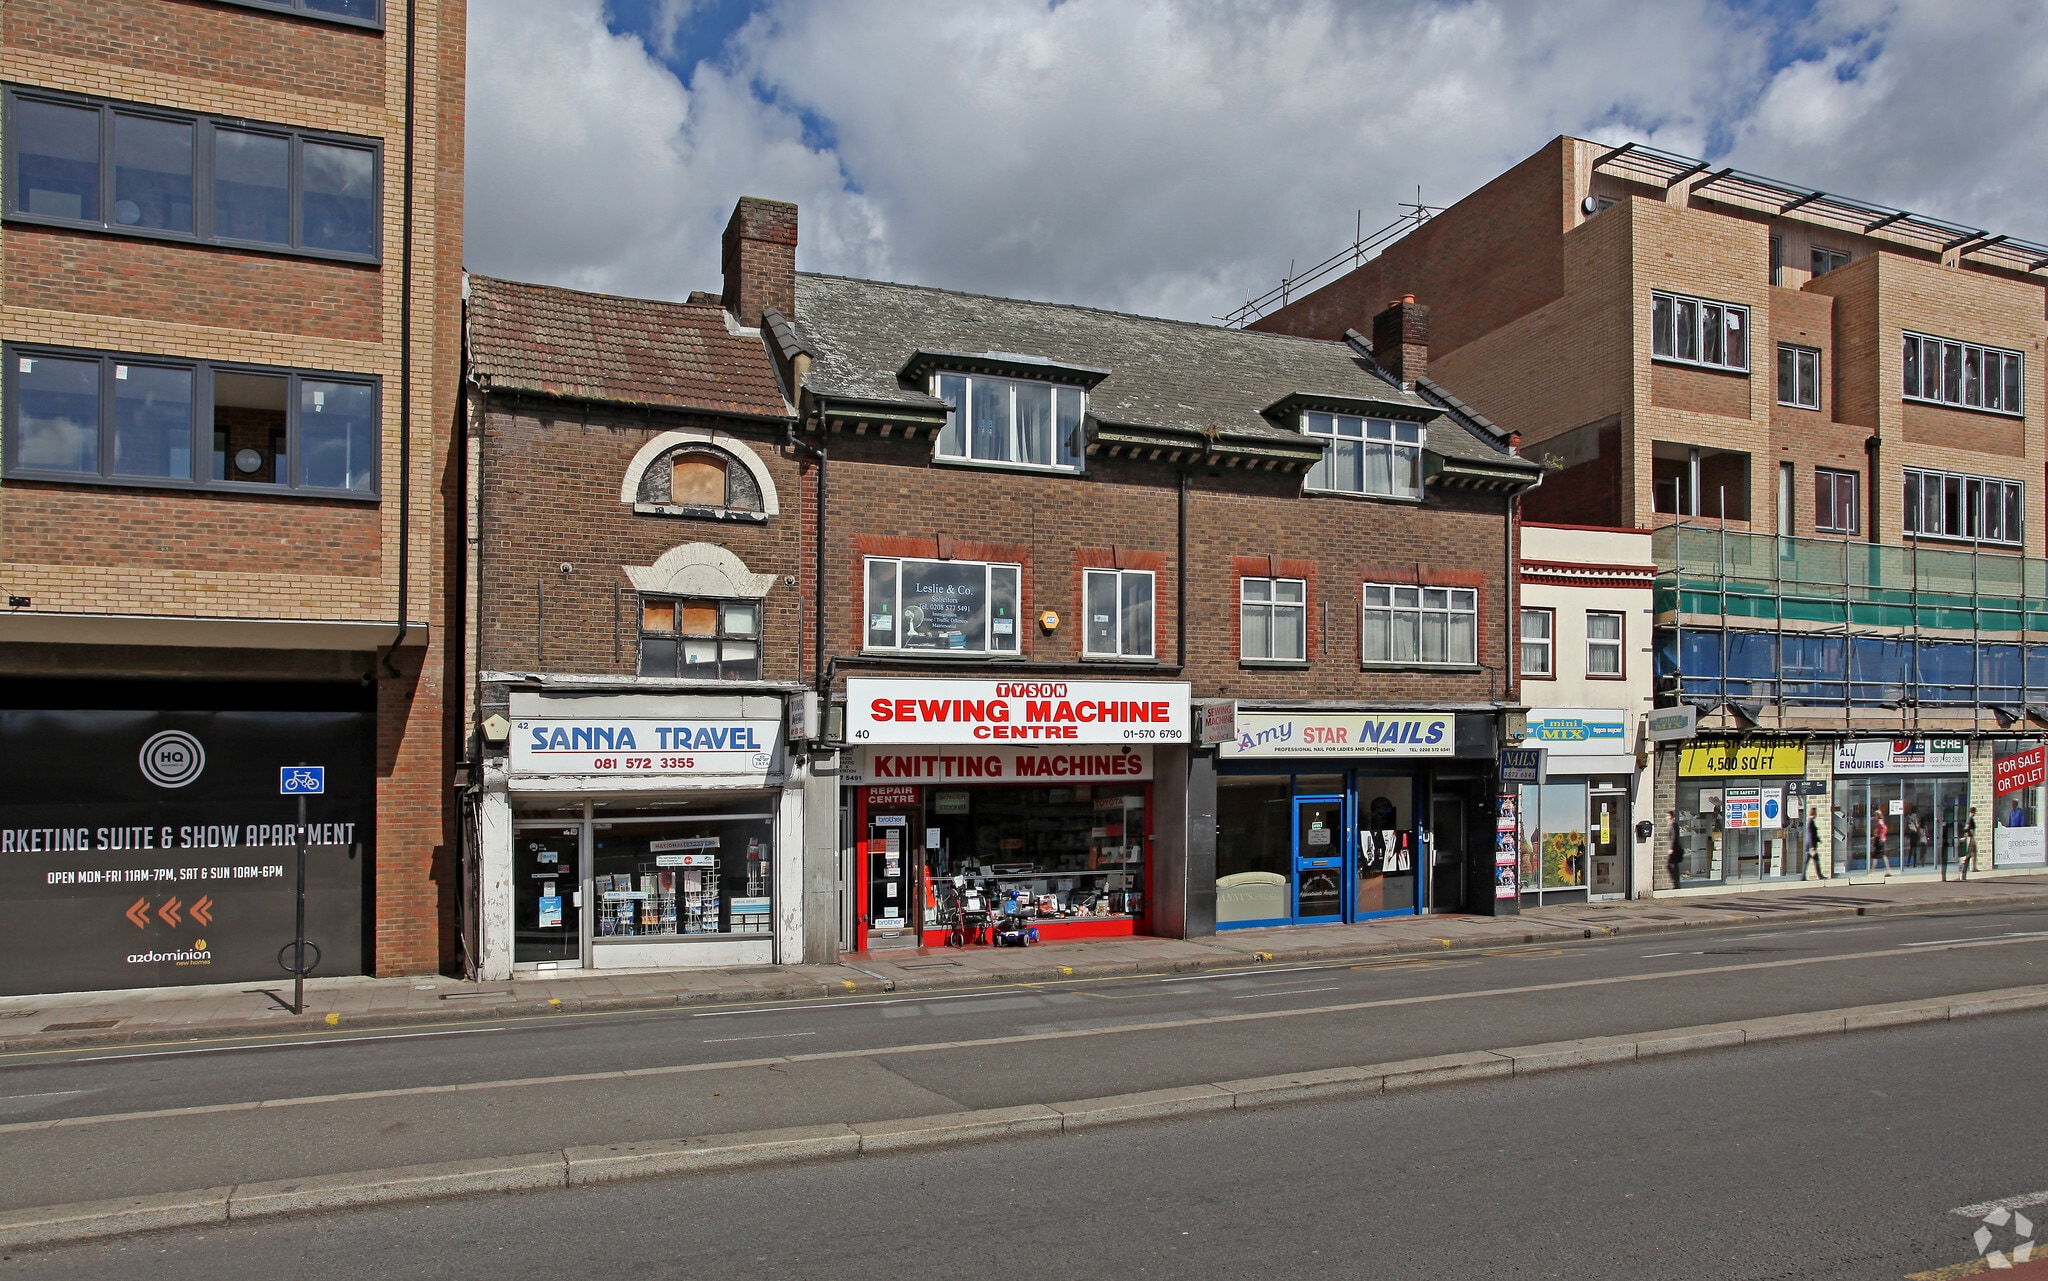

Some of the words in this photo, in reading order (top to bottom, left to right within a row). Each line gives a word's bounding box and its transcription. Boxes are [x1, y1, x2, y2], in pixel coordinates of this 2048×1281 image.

[916, 583, 944, 593] Leslie
[946, 585, 955, 594] &
[957, 586, 973, 595] Co.
[998, 684, 1066, 697] TYSON
[871, 699, 1009, 722] SEWING
[1026, 701, 1170, 722] MACHINE
[1208, 705, 1232, 717] SEWING
[1206, 715, 1233, 726] MACHINE
[855, 730, 870, 739] 40
[973, 726, 1078, 739] CENTRE
[1123, 730, 1155, 739] 01-570
[1159, 730, 1182, 739] 6790
[1238, 721, 1292, 752] Amy
[1303, 727, 1348, 744] STAR
[1359, 720, 1446, 744] NAILS
[1541, 729, 1584, 739] MIX
[531, 727, 637, 750] SANNA
[655, 727, 761, 750] TRAVEL
[1689, 738, 1718, 749] NEW
[1932, 739, 1961, 749] CBRE
[161, 752, 184, 762] HQ
[1840, 748, 1855, 757] ALL
[594, 758, 617, 769] 081
[626, 758, 652, 769] 572
[660, 758, 695, 769] 3355
[1504, 752, 1537, 766] NAILS
[1707, 757, 1738, 772] 4,500
[1742, 756, 1758, 770] SQ
[1761, 756, 1774, 770] FT
[1998, 759, 2017, 774] FOR
[2018, 752, 2041, 768] SALE
[875, 756, 1002, 777] KNITTING
[1016, 754, 1143, 777] MACHINES
[1840, 761, 1885, 769] ENQUIRIES
[1998, 778, 2011, 792] OR
[2012, 773, 2026, 787] TO
[2027, 768, 2043, 782] LET
[870, 786, 913, 795] REPAIR
[868, 795, 915, 803] CENTRE
[1095, 798, 1123, 807] TOYOTA
[2, 828, 89, 852] RKETING
[97, 827, 153, 850] SUITE
[161, 826, 174, 849] &
[180, 825, 239, 848] SHOW
[246, 823, 356, 847] APARMENT
[2008, 839, 2039, 849] groceries
[1996, 851, 2011, 860] milk
[48, 872, 75, 884] OPEN
[78, 870, 122, 883] MON-FRI
[125, 869, 177, 882] 11AM-7PM,
[180, 867, 198, 880] SAT
[201, 867, 208, 880] &
[211, 866, 230, 879] SUN
[233, 865, 283, 878] 10AM-6PM
[127, 949, 211, 963] a2dominion
